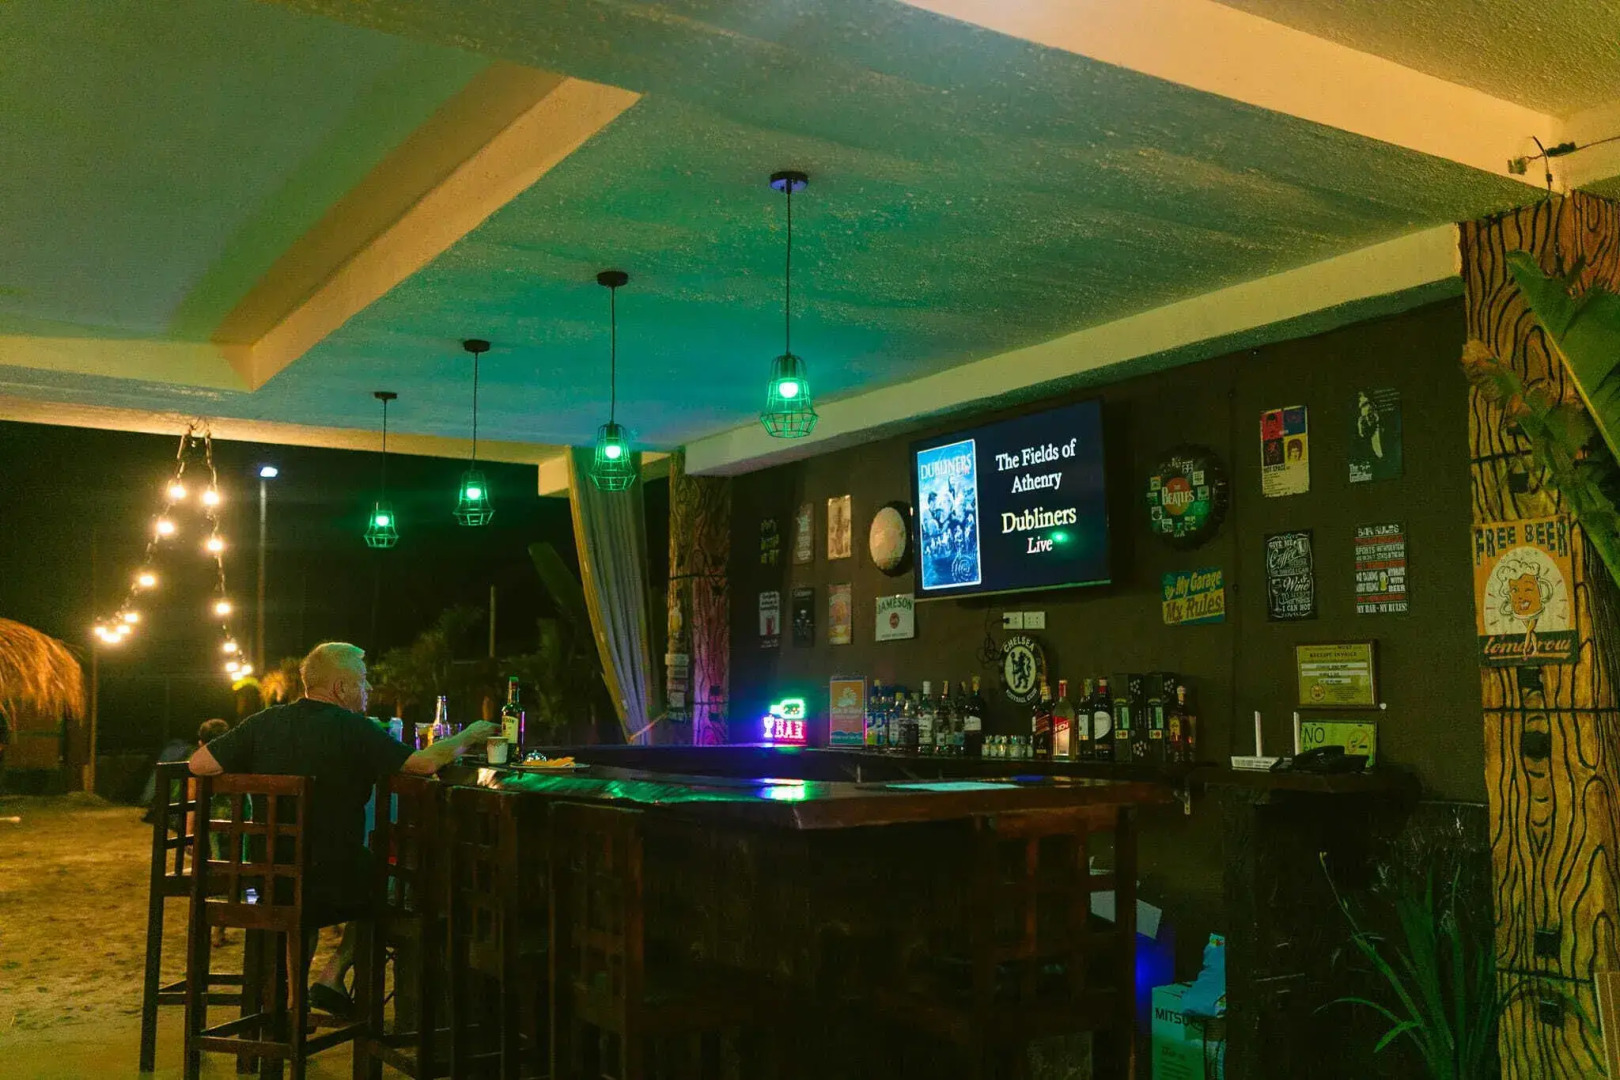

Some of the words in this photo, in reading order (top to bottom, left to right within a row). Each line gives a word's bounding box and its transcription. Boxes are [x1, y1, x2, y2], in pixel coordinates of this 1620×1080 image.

[996, 453, 1020, 471] The
[1021, 443, 1059, 466] Fields
[1062, 438, 1077, 458] of
[920, 453, 972, 480] DUBLINERS
[1011, 472, 1062, 493] Athenry
[1162, 486, 1195, 507] BEATLES
[1001, 506, 1077, 534] Dubliners
[1027, 536, 1053, 554] Live
[1475, 526, 1516, 566] FREE
[1525, 516, 1568, 557] BEER
[1176, 576, 1190, 598] My
[1190, 570, 1221, 592] Garage
[878, 598, 912, 614] JAMESON
[1186, 594, 1222, 616] Rules
[1004, 636, 1035, 652] CHELSEA
[1304, 728, 1324, 743] NO
